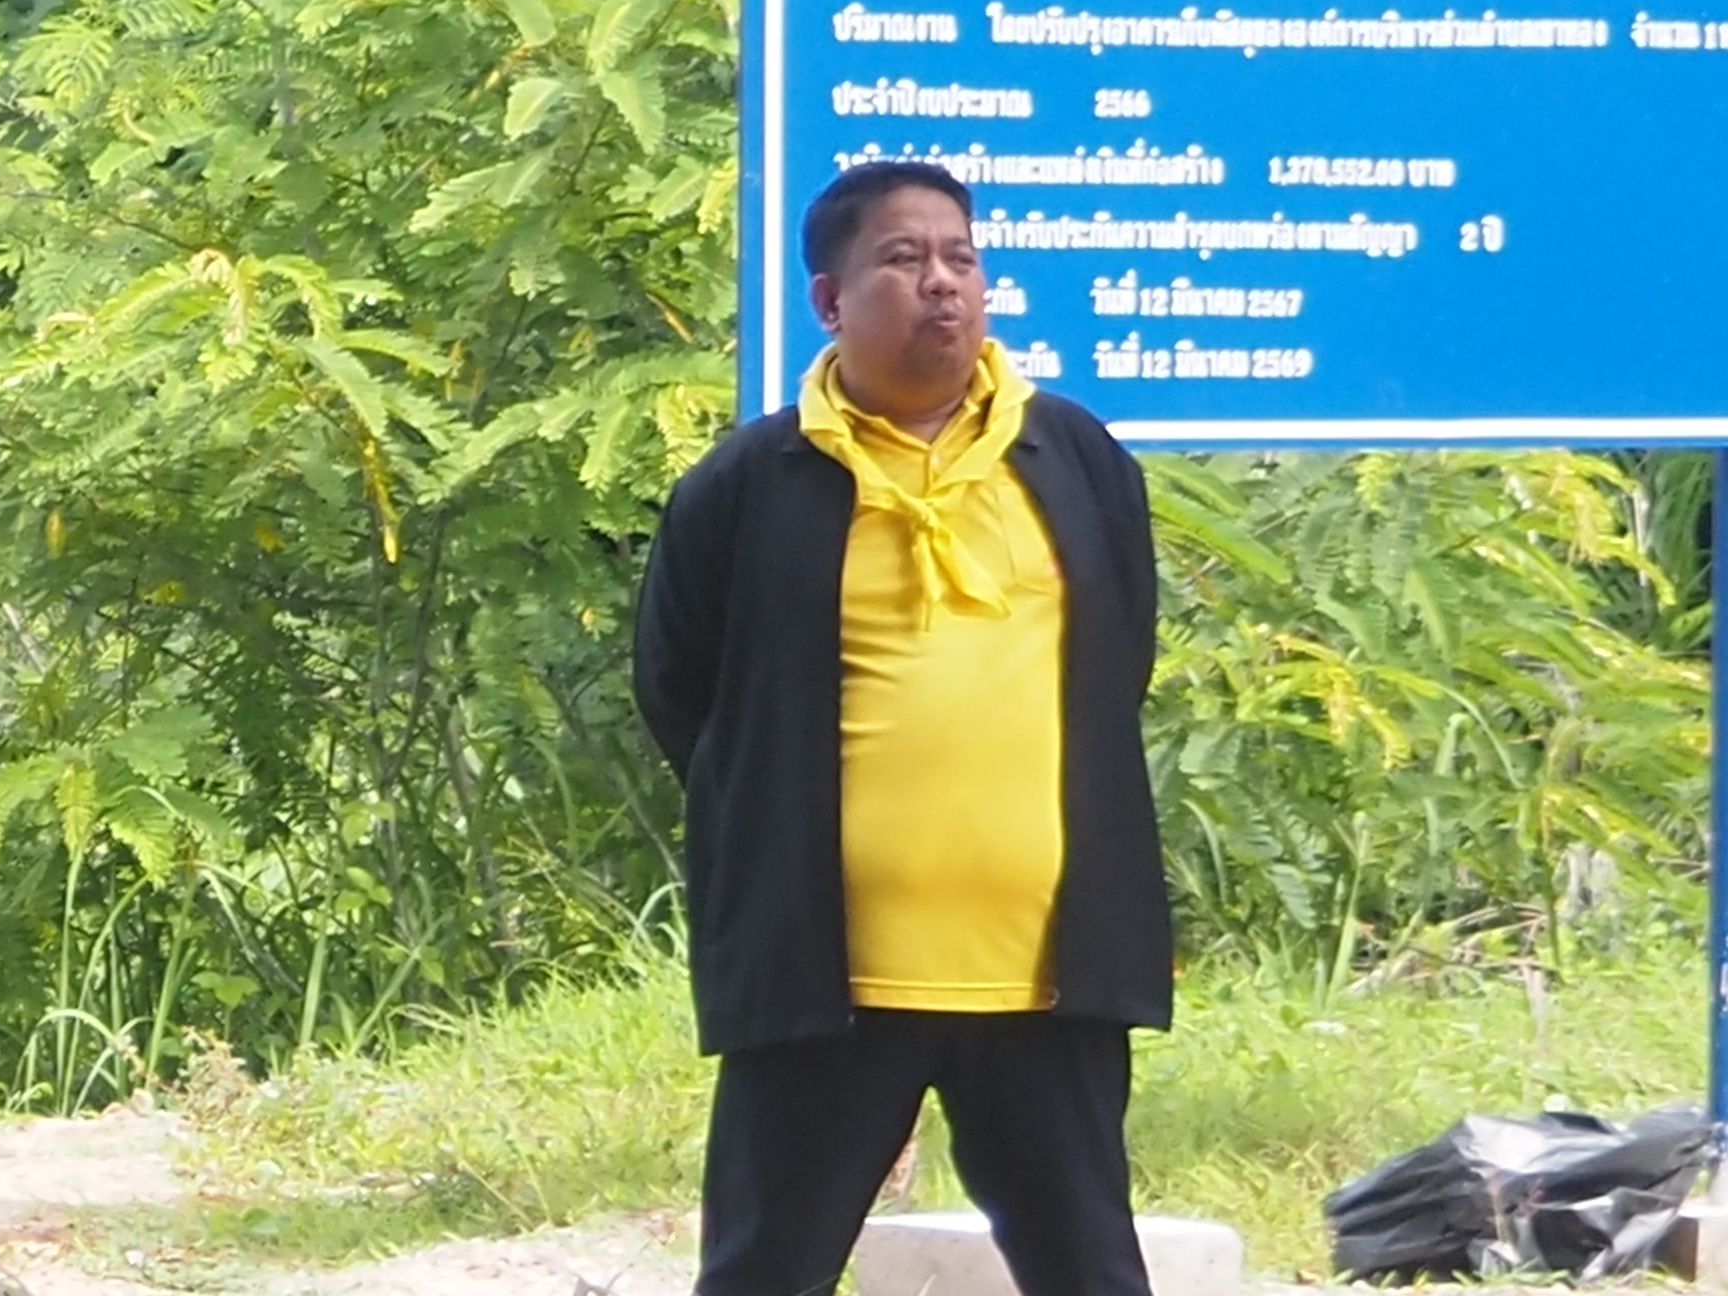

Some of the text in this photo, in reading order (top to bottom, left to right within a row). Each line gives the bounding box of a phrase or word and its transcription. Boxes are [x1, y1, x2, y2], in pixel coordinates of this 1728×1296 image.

[833, 2, 958, 43] ปริมาณงาน
[832, 77, 1033, 118] ประจำปีงบประมาณ
[1406, 159, 1455, 187] บาท
[1460, 222, 1479, 251] 2
[1481, 215, 1503, 252] ปี
[1090, 269, 1138, 315] วันที่
[1138, 287, 1170, 316] 12
[1093, 332, 1142, 378] วันที่
[1139, 349, 1172, 378] 12
